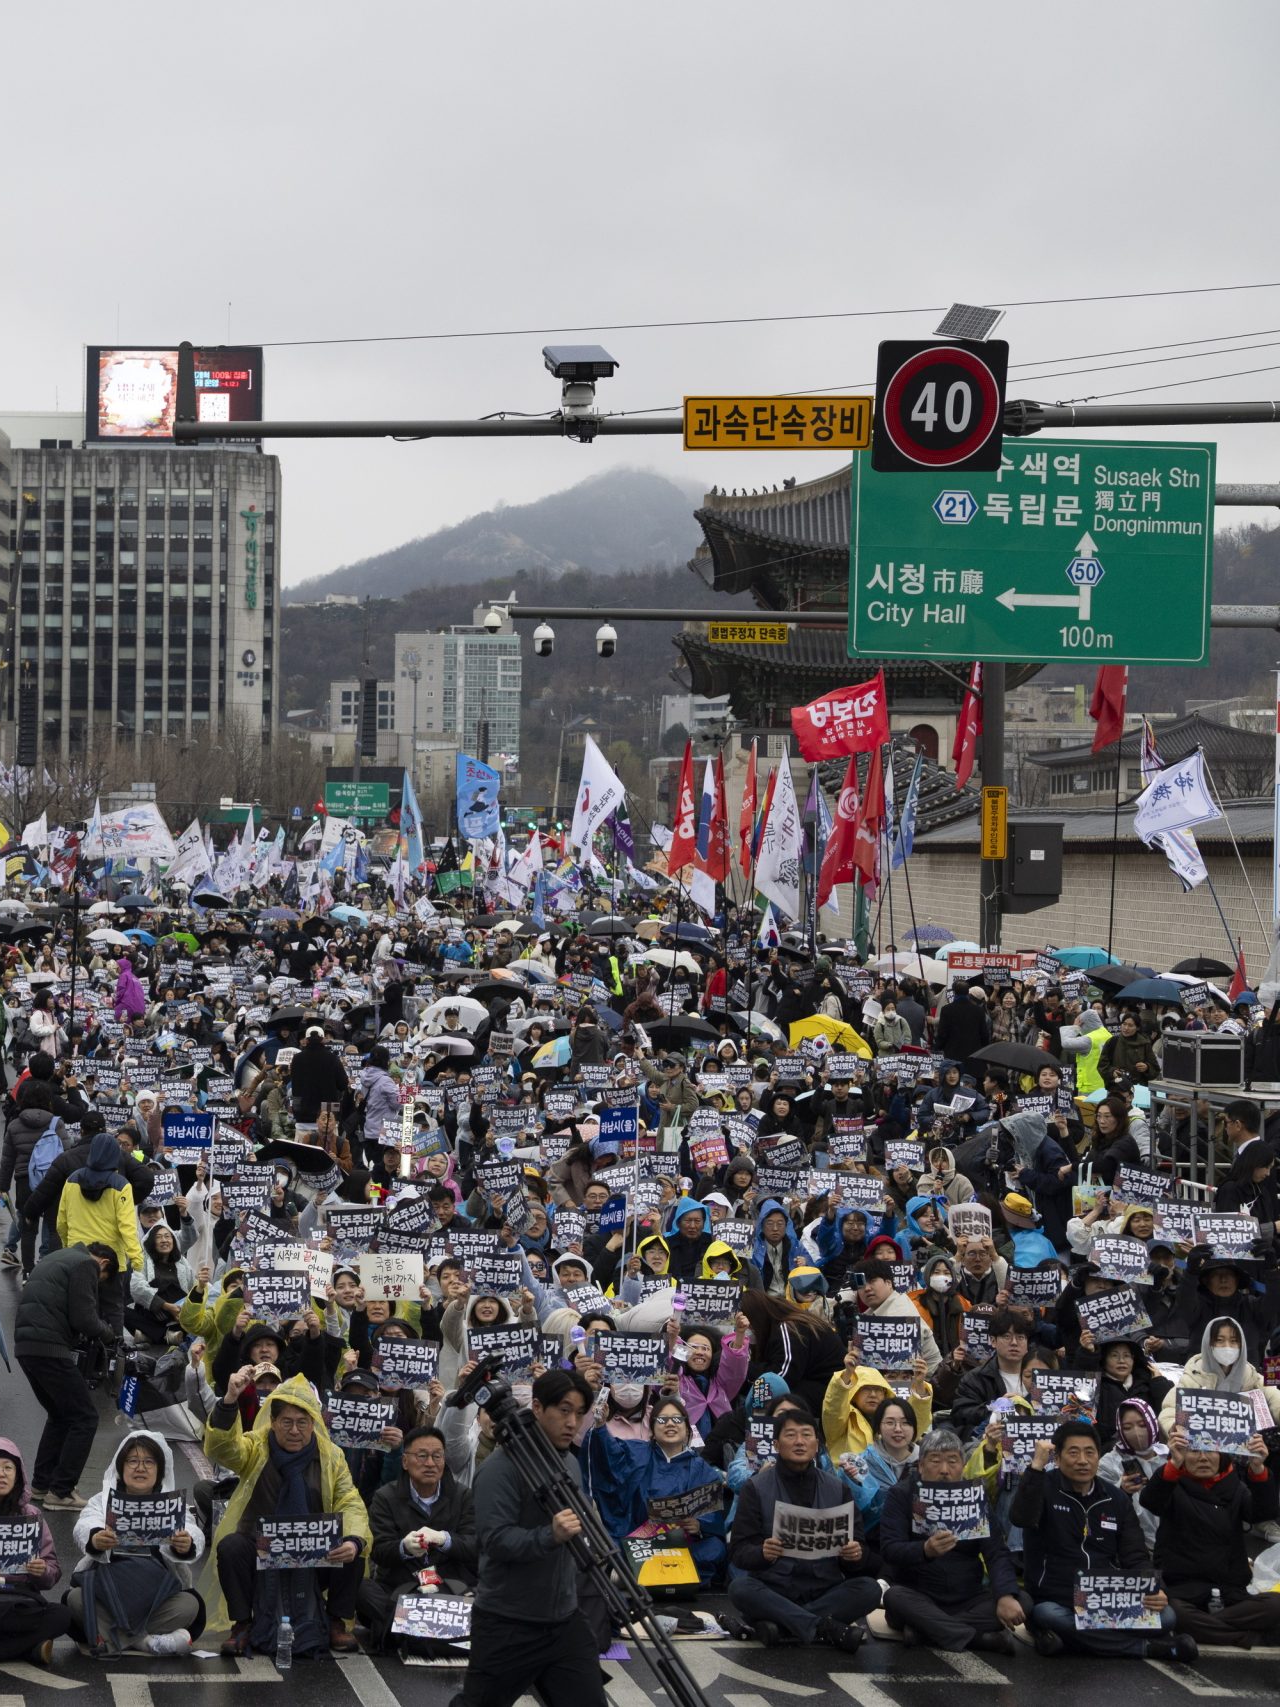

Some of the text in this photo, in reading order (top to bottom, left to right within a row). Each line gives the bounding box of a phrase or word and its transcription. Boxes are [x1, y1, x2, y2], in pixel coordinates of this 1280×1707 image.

[911, 381, 973, 433] 40
[694, 404, 864, 441] 과속단속장비
[1094, 466, 1200, 487] Susaek Stn
[944, 499, 968, 517] 21
[984, 493, 1081, 525] 독립문
[1095, 492, 1161, 512] 獨立門
[1094, 515, 1202, 536] Dongnimmun
[866, 563, 984, 595] 시청 市廳
[1074, 562, 1096, 582] 50
[868, 602, 965, 626] City Hall
[711, 626, 786, 641] 불법주정차 단속중
[1059, 626, 1113, 648] 100m
[775, 1058, 806, 1067] 민주주의가
[827, 1054, 858, 1063] 민주주의가
[830, 1062, 853, 1072] 승리했다
[777, 1066, 804, 1076] 승리했다
[168, 1124, 212, 1140] 하남시(을)
[600, 1119, 637, 1134] 하남시(을)
[1120, 1167, 1171, 1189] 민주주의가
[953, 1210, 991, 1224] 내란세력
[1198, 1219, 1257, 1233] 민주주의가
[378, 1231, 429, 1249] 민주주의가
[1094, 1238, 1148, 1256] 민주주의가
[277, 1250, 317, 1262] 시작의 끝이
[376, 1257, 405, 1272] 국힘당
[1100, 1251, 1145, 1269] 승리했다
[247, 1276, 308, 1291] 민주주의가
[372, 1274, 416, 1284] 해체까지
[252, 1290, 303, 1305] 승리했다
[383, 1286, 405, 1297] 투쟁!
[680, 1283, 741, 1299] 민주주의가
[1078, 1291, 1137, 1319] 민주주의가
[1086, 1305, 1135, 1331] 승리했다
[859, 1321, 917, 1338] 민주주의가
[471, 1330, 539, 1348] 민주주의가
[598, 1337, 666, 1353] 민주주의가
[863, 1337, 913, 1353] 승리했다
[378, 1342, 438, 1361] 민주주의가
[604, 1352, 659, 1369] 승리했다
[382, 1357, 434, 1375] 승리했다
[1036, 1375, 1097, 1392] 민주주의가
[326, 1400, 394, 1418] 민주주의가
[1181, 1394, 1253, 1420] 민주주의가
[1188, 1413, 1250, 1435] 승리했다
[652, 1483, 719, 1512] 민주주의가
[919, 1485, 984, 1504] 민주주의가
[111, 1496, 183, 1515] 민주주의가
[925, 1503, 982, 1522] 승리했다
[115, 1513, 177, 1531] 승리했다
[262, 1519, 339, 1537] 민주주의가
[779, 1514, 849, 1534] 내란세력
[269, 1536, 331, 1553] 승리했다
[632, 1547, 682, 1559] GREEN
[1080, 1575, 1156, 1592] 민주주의가
[407, 1609, 469, 1630] 승리했다
